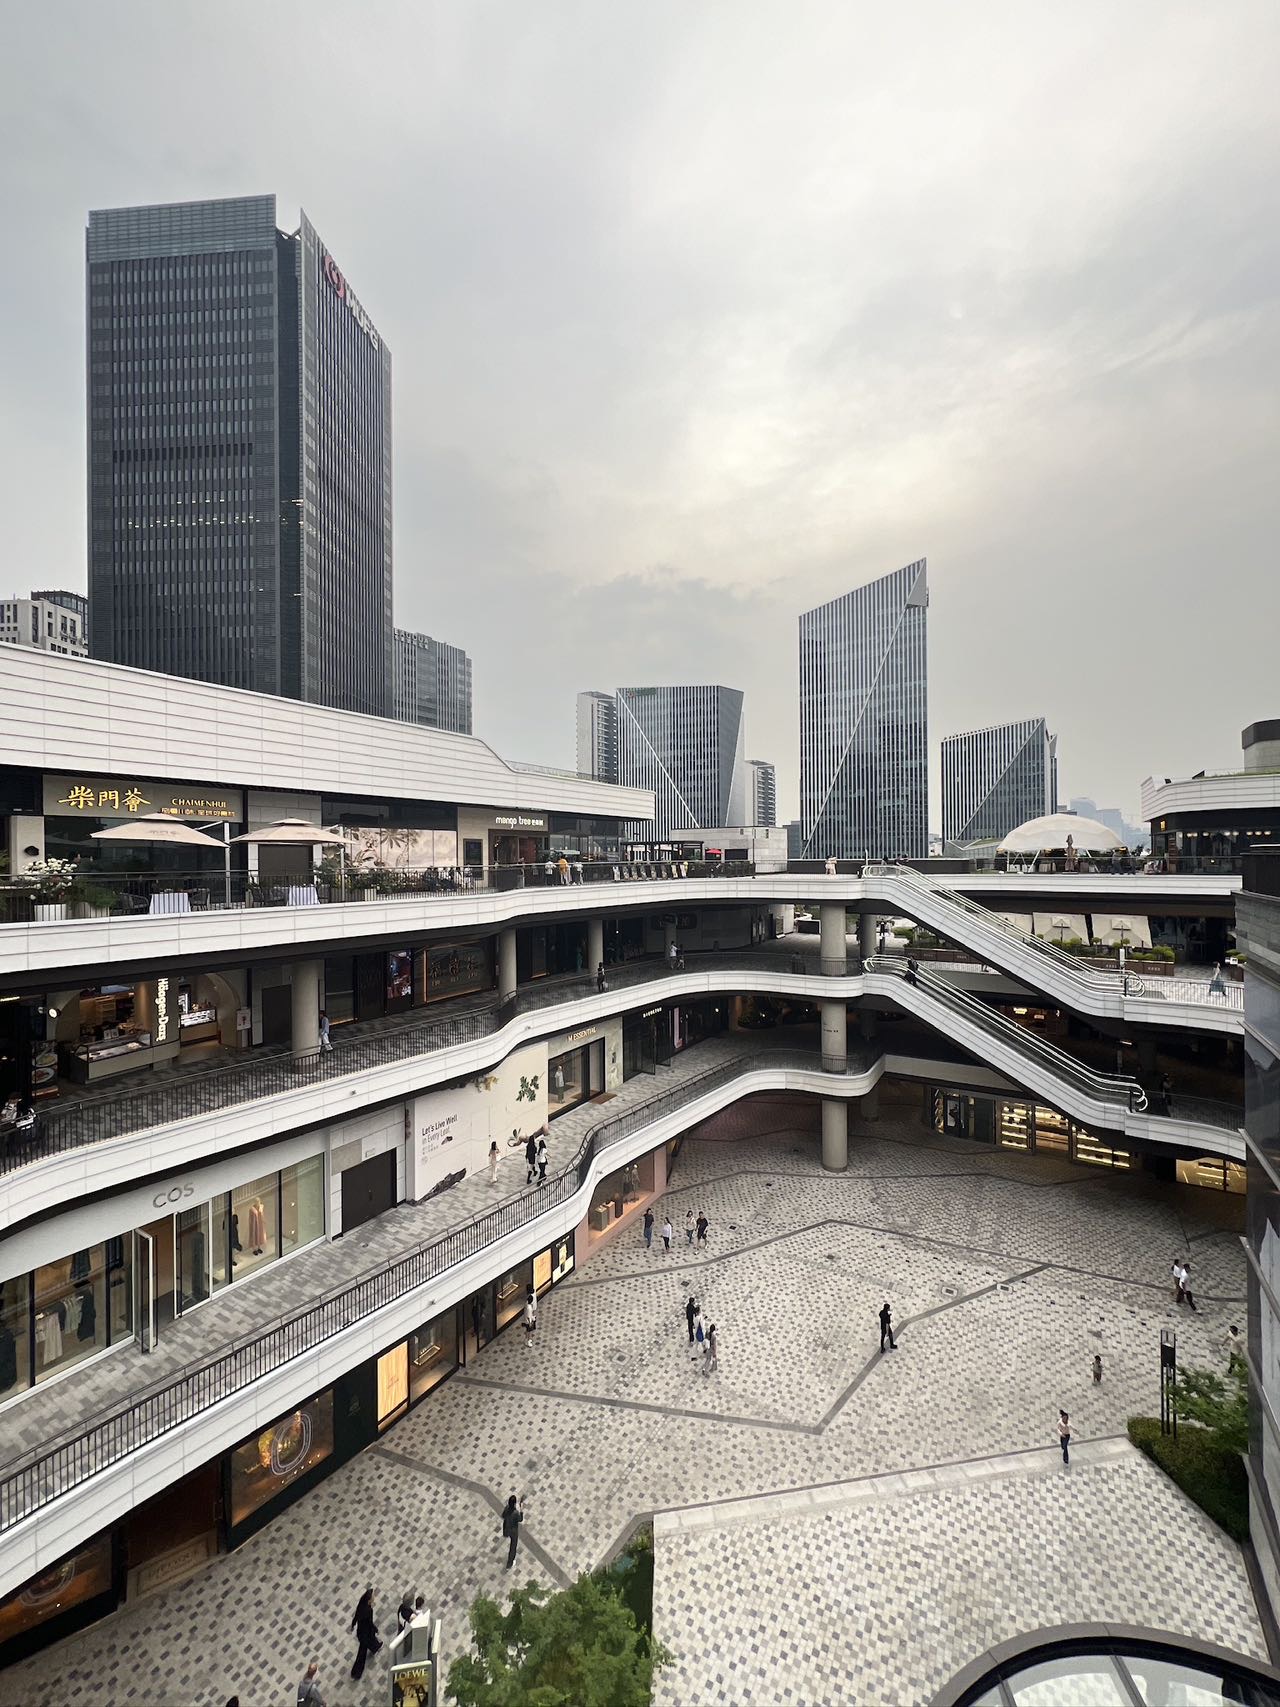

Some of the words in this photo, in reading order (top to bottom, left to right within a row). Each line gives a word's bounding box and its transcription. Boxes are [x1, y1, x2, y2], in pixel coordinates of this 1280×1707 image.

[345, 283, 379, 351] MUFG
[171, 798, 227, 808] CHAIMENHUI
[495, 816, 517, 829] mango
[518, 815, 531, 826] tree
[154, 977, 169, 1042] Häagen-Dazs
[421, 1124, 434, 1136] Let's
[435, 1120, 446, 1131] Live
[446, 1113, 458, 1125] Well
[152, 1182, 195, 1208] COS
[394, 1668, 428, 1682] LOEWE
